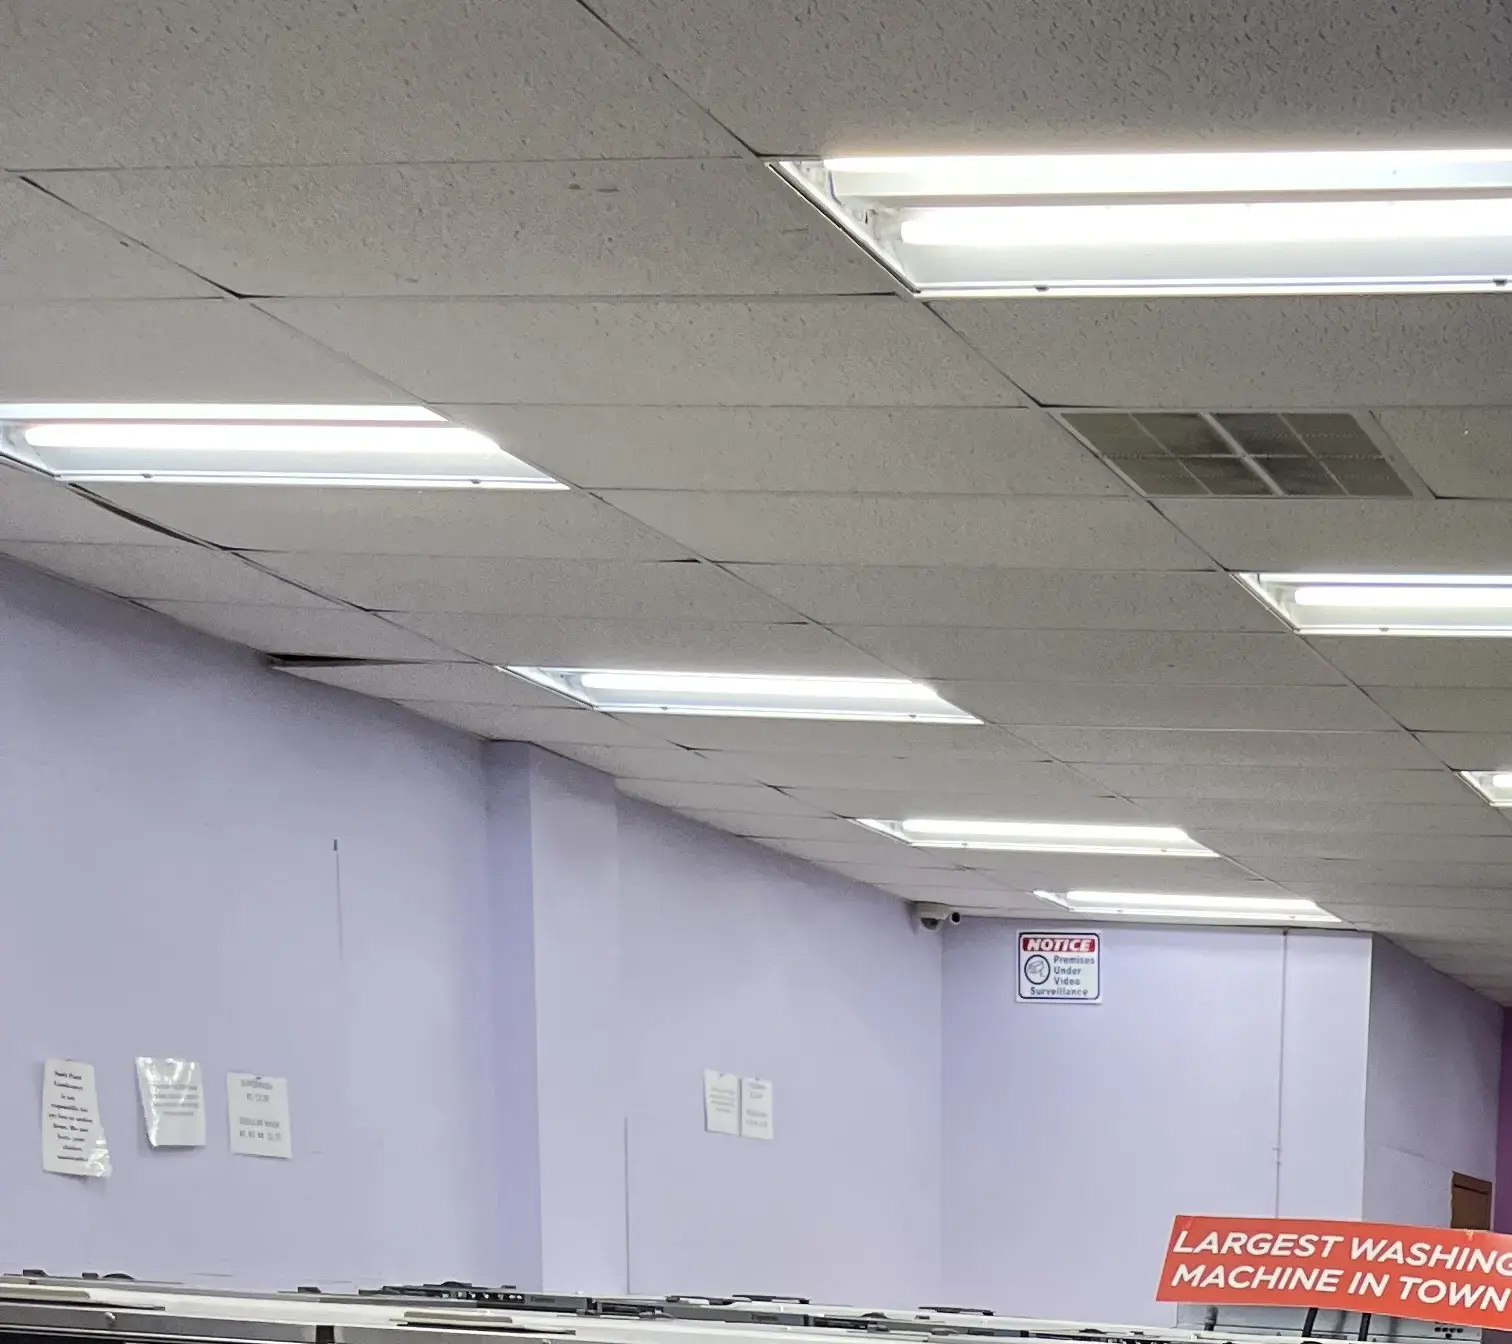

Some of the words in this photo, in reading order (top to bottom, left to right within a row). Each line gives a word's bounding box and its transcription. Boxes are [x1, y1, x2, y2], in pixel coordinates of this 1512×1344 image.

[1026, 938, 1091, 952] NOTICE
[1053, 955, 1095, 964] Premises
[1053, 967, 1082, 975] Under
[1053, 977, 1081, 985] Video
[1030, 987, 1089, 996] Surveillance
[1172, 1230, 1344, 1259] LARGEST
[1170, 1264, 1345, 1293] MACHINE
[1348, 1271, 1391, 1298] IN
[1398, 1276, 1512, 1312] TOWN
